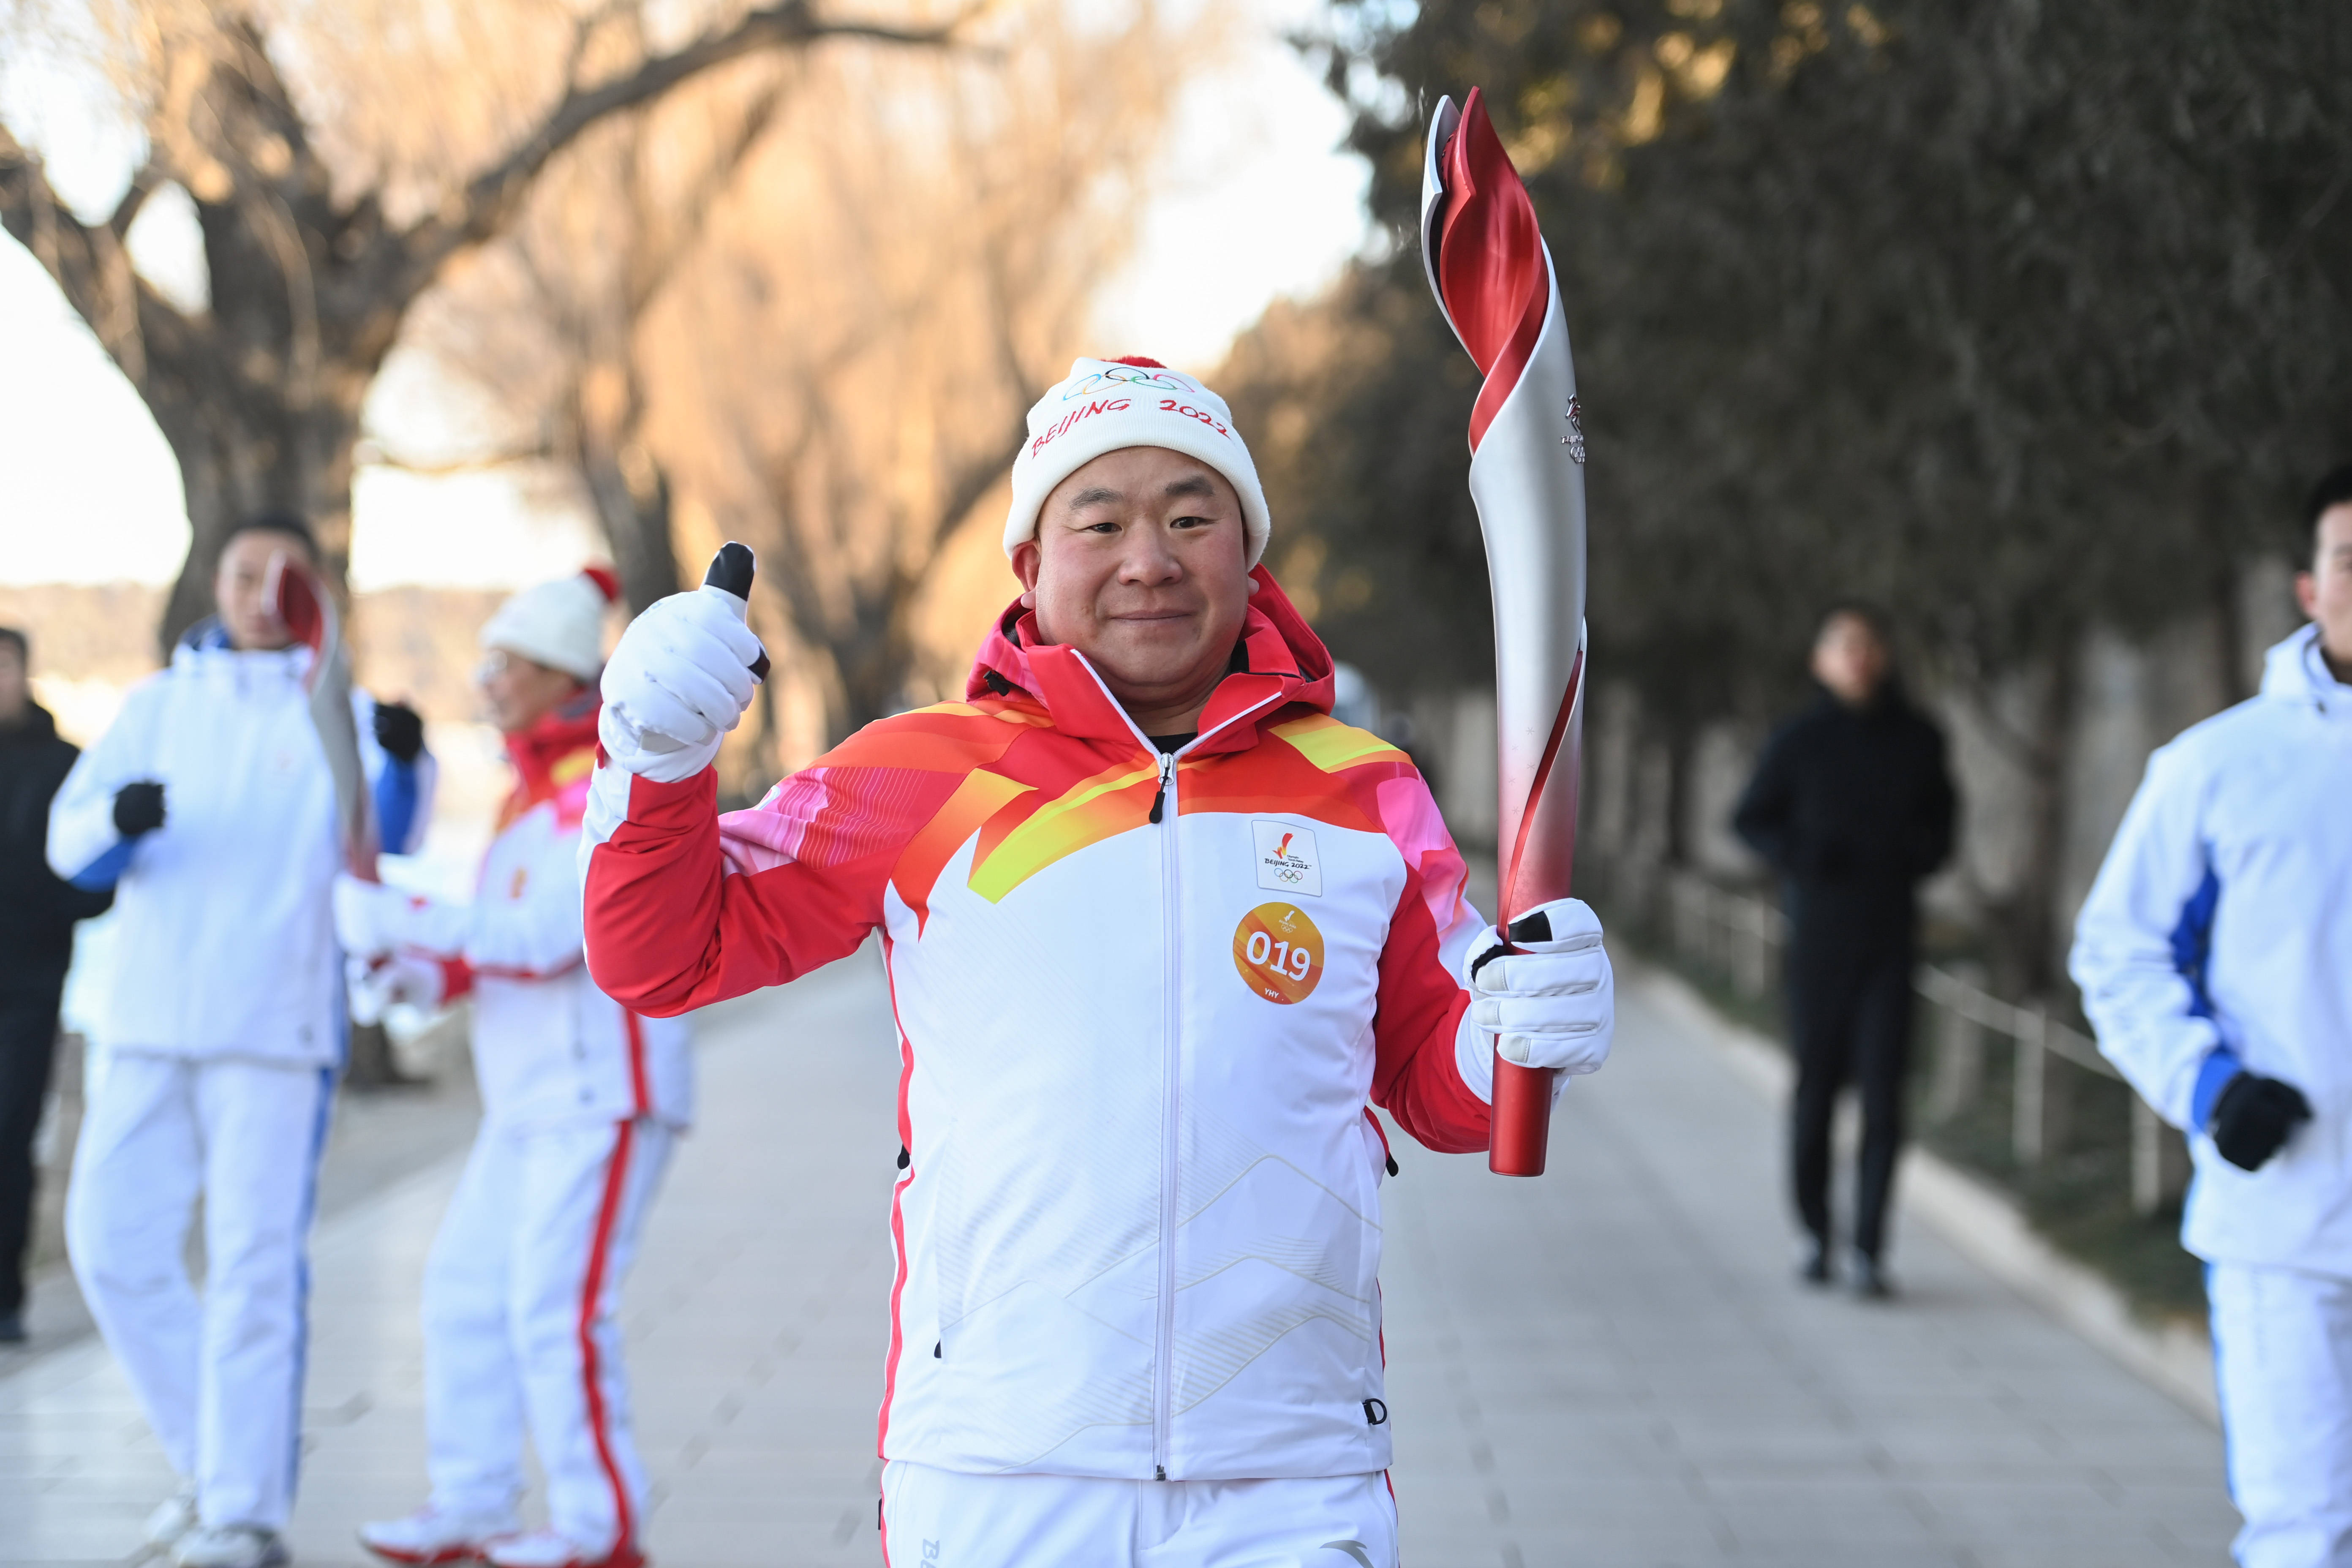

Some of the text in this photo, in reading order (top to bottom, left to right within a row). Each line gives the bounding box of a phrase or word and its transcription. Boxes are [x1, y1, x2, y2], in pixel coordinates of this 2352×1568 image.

[1032, 399, 1232, 460] BEIJING 2022
[1265, 858, 1289, 867] BEIJING
[1247, 931, 1310, 981] 019
[1265, 988, 1279, 998] YHY
